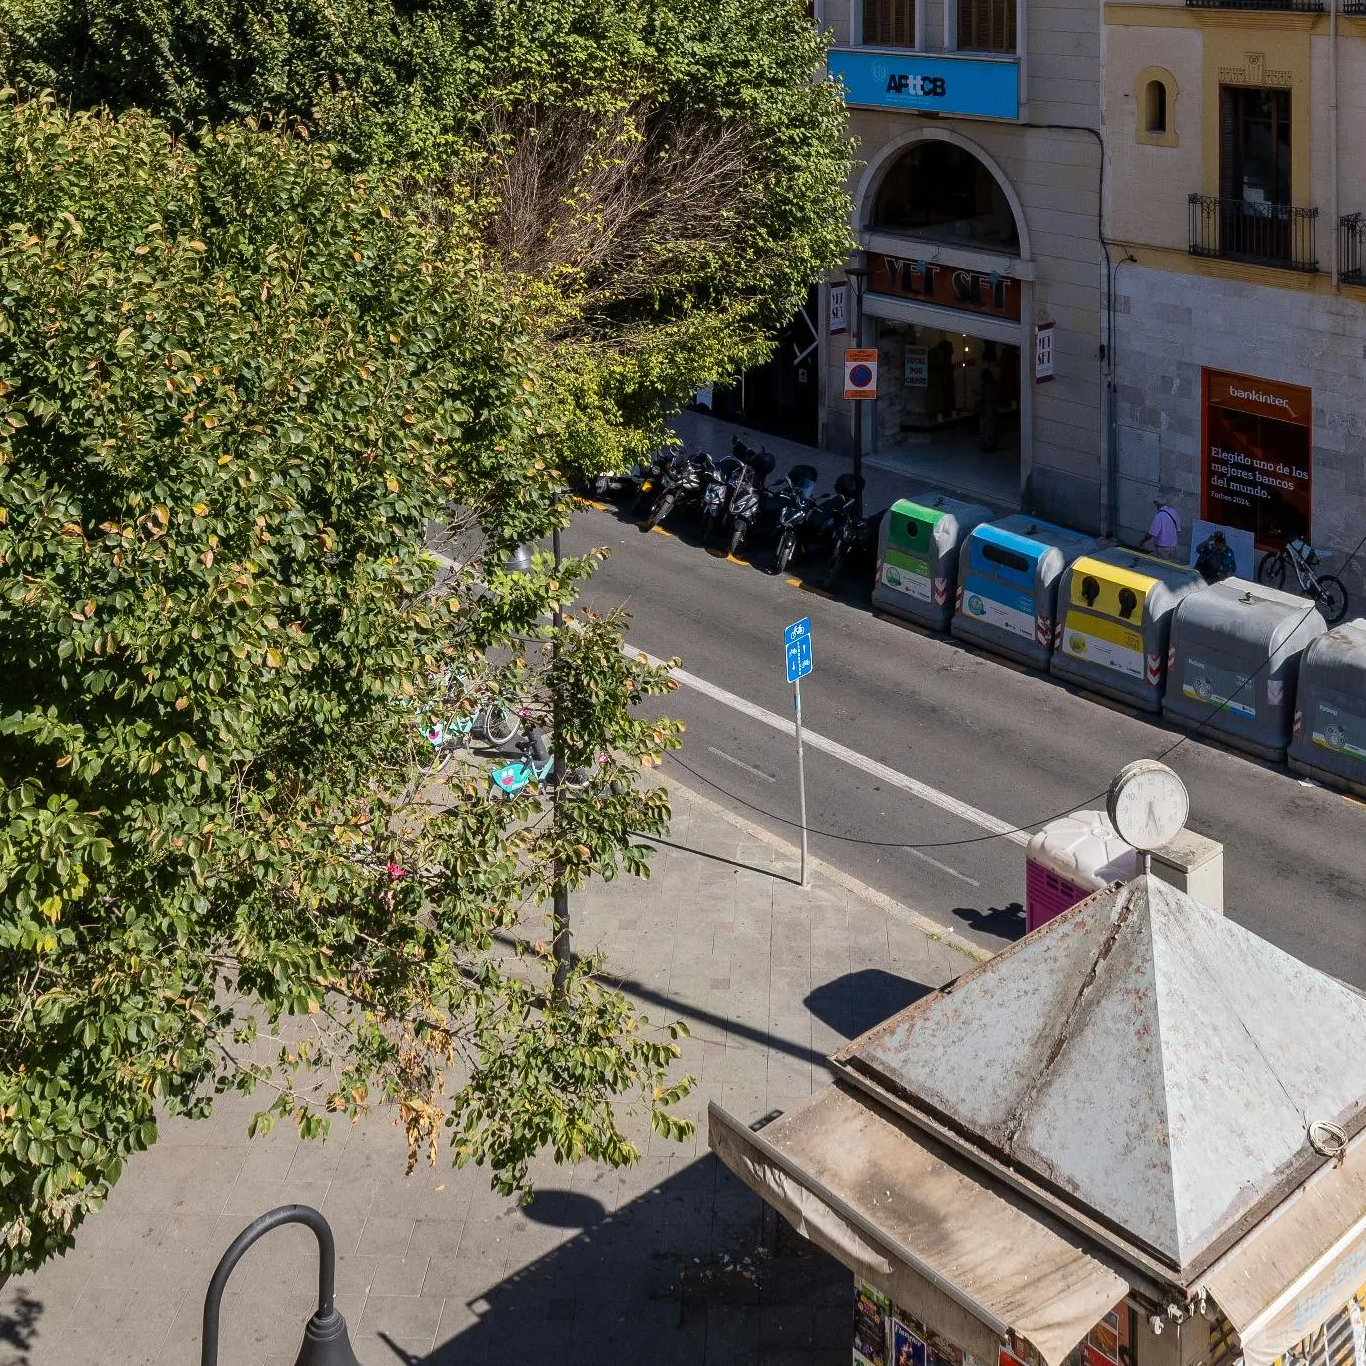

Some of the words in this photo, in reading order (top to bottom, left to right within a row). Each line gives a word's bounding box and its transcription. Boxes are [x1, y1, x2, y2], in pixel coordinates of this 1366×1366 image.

[1229, 385, 1290, 409] bankinter.
[1211, 446, 1251, 465] Elegido
[1253, 459, 1274, 471] uno
[1276, 463, 1289, 475] de
[1292, 465, 1309, 480] los
[1211, 462, 1254, 480] mejores
[1256, 471, 1295, 490] bancos
[1211, 475, 1227, 488] del
[1229, 481, 1271, 499] mundo.
